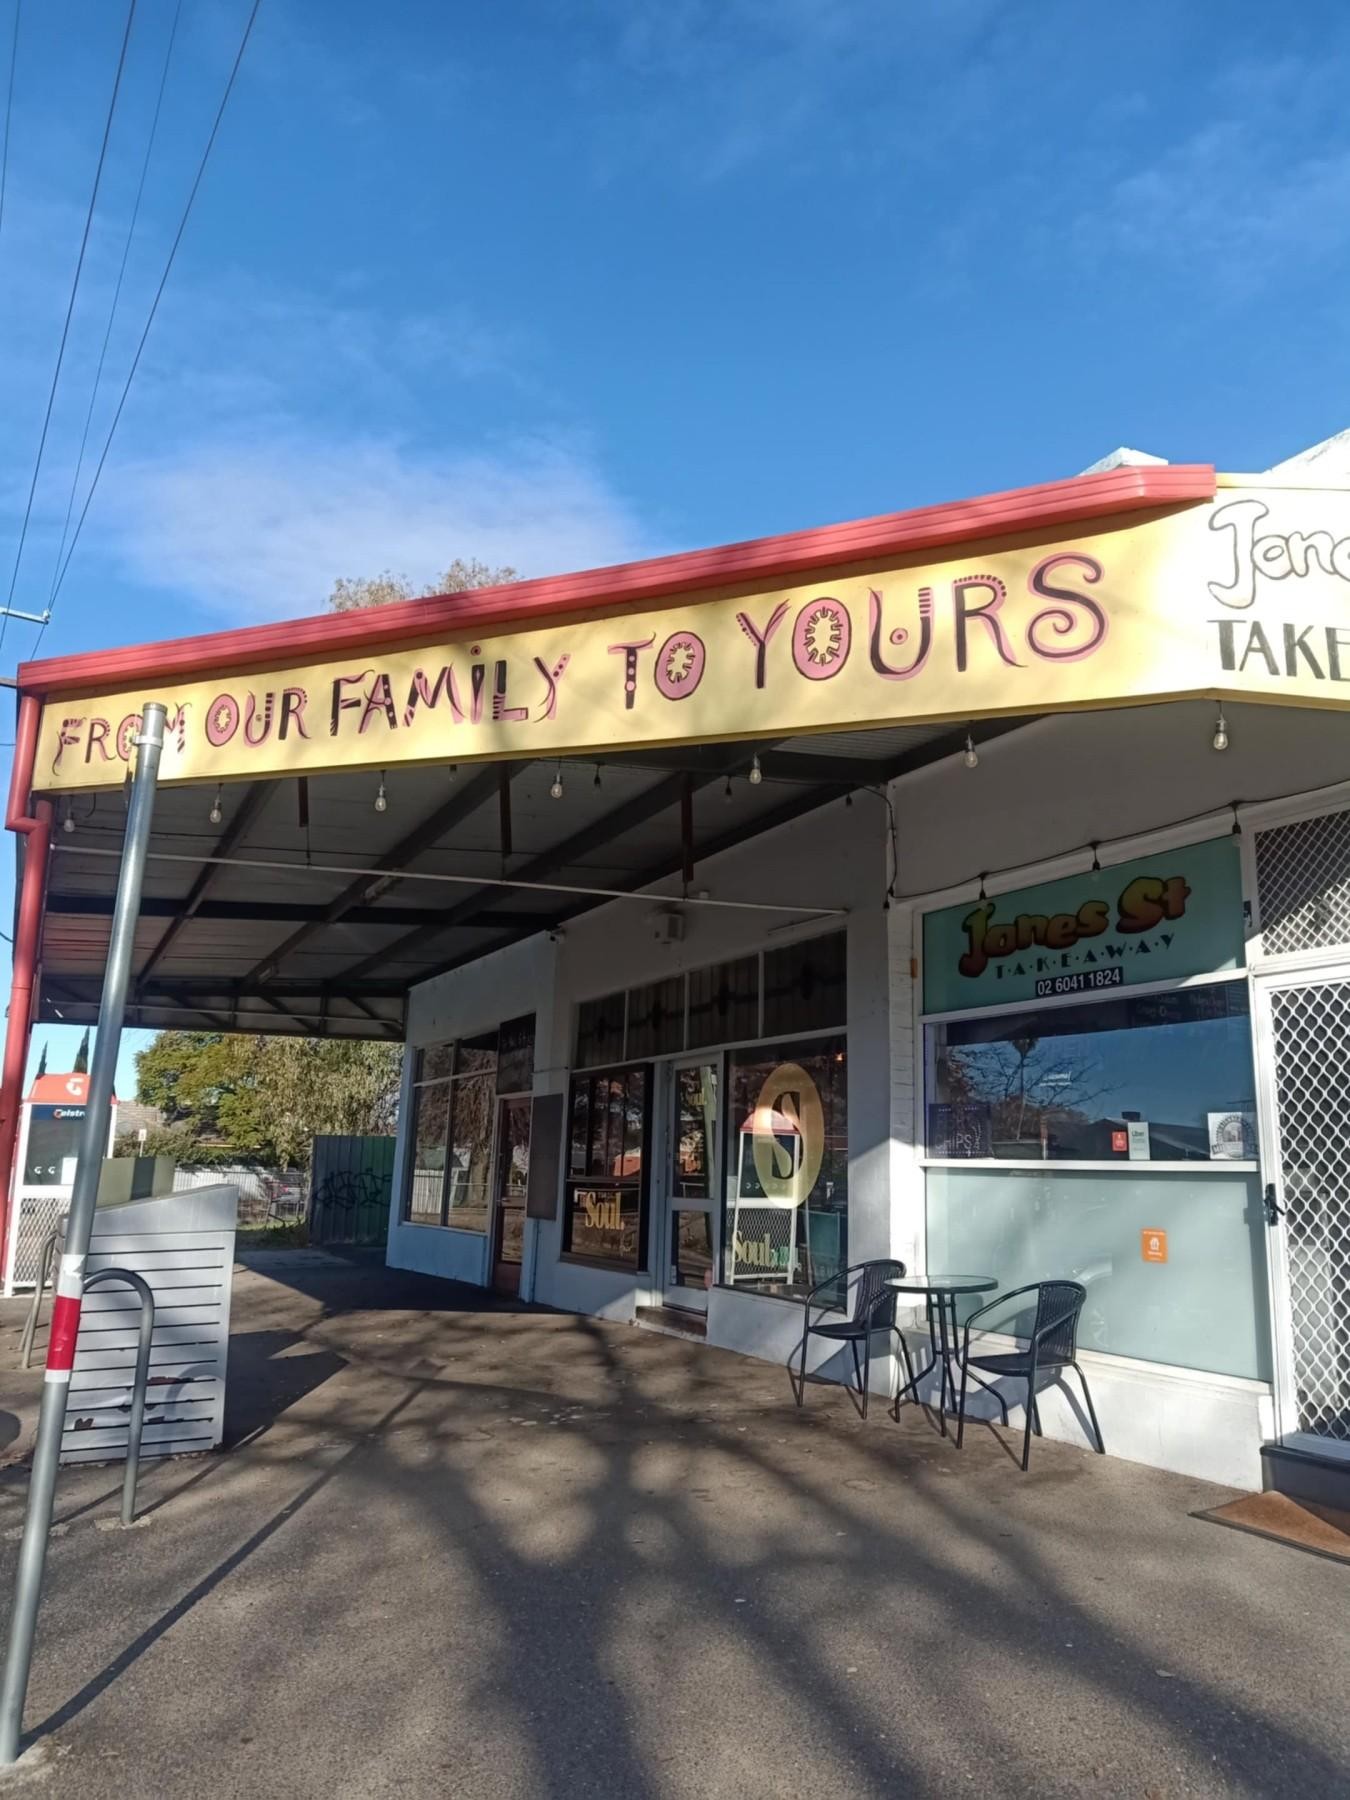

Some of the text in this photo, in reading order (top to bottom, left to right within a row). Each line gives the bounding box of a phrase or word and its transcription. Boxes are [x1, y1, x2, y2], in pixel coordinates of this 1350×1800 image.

[205, 686, 311, 749] OUR
[608, 631, 706, 709] TO
[736, 551, 1110, 690] YOURS
[1207, 619, 1350, 682] TAKE
[1115, 875, 1192, 934] St
[1037, 967, 1121, 996] 02 6041 1824
